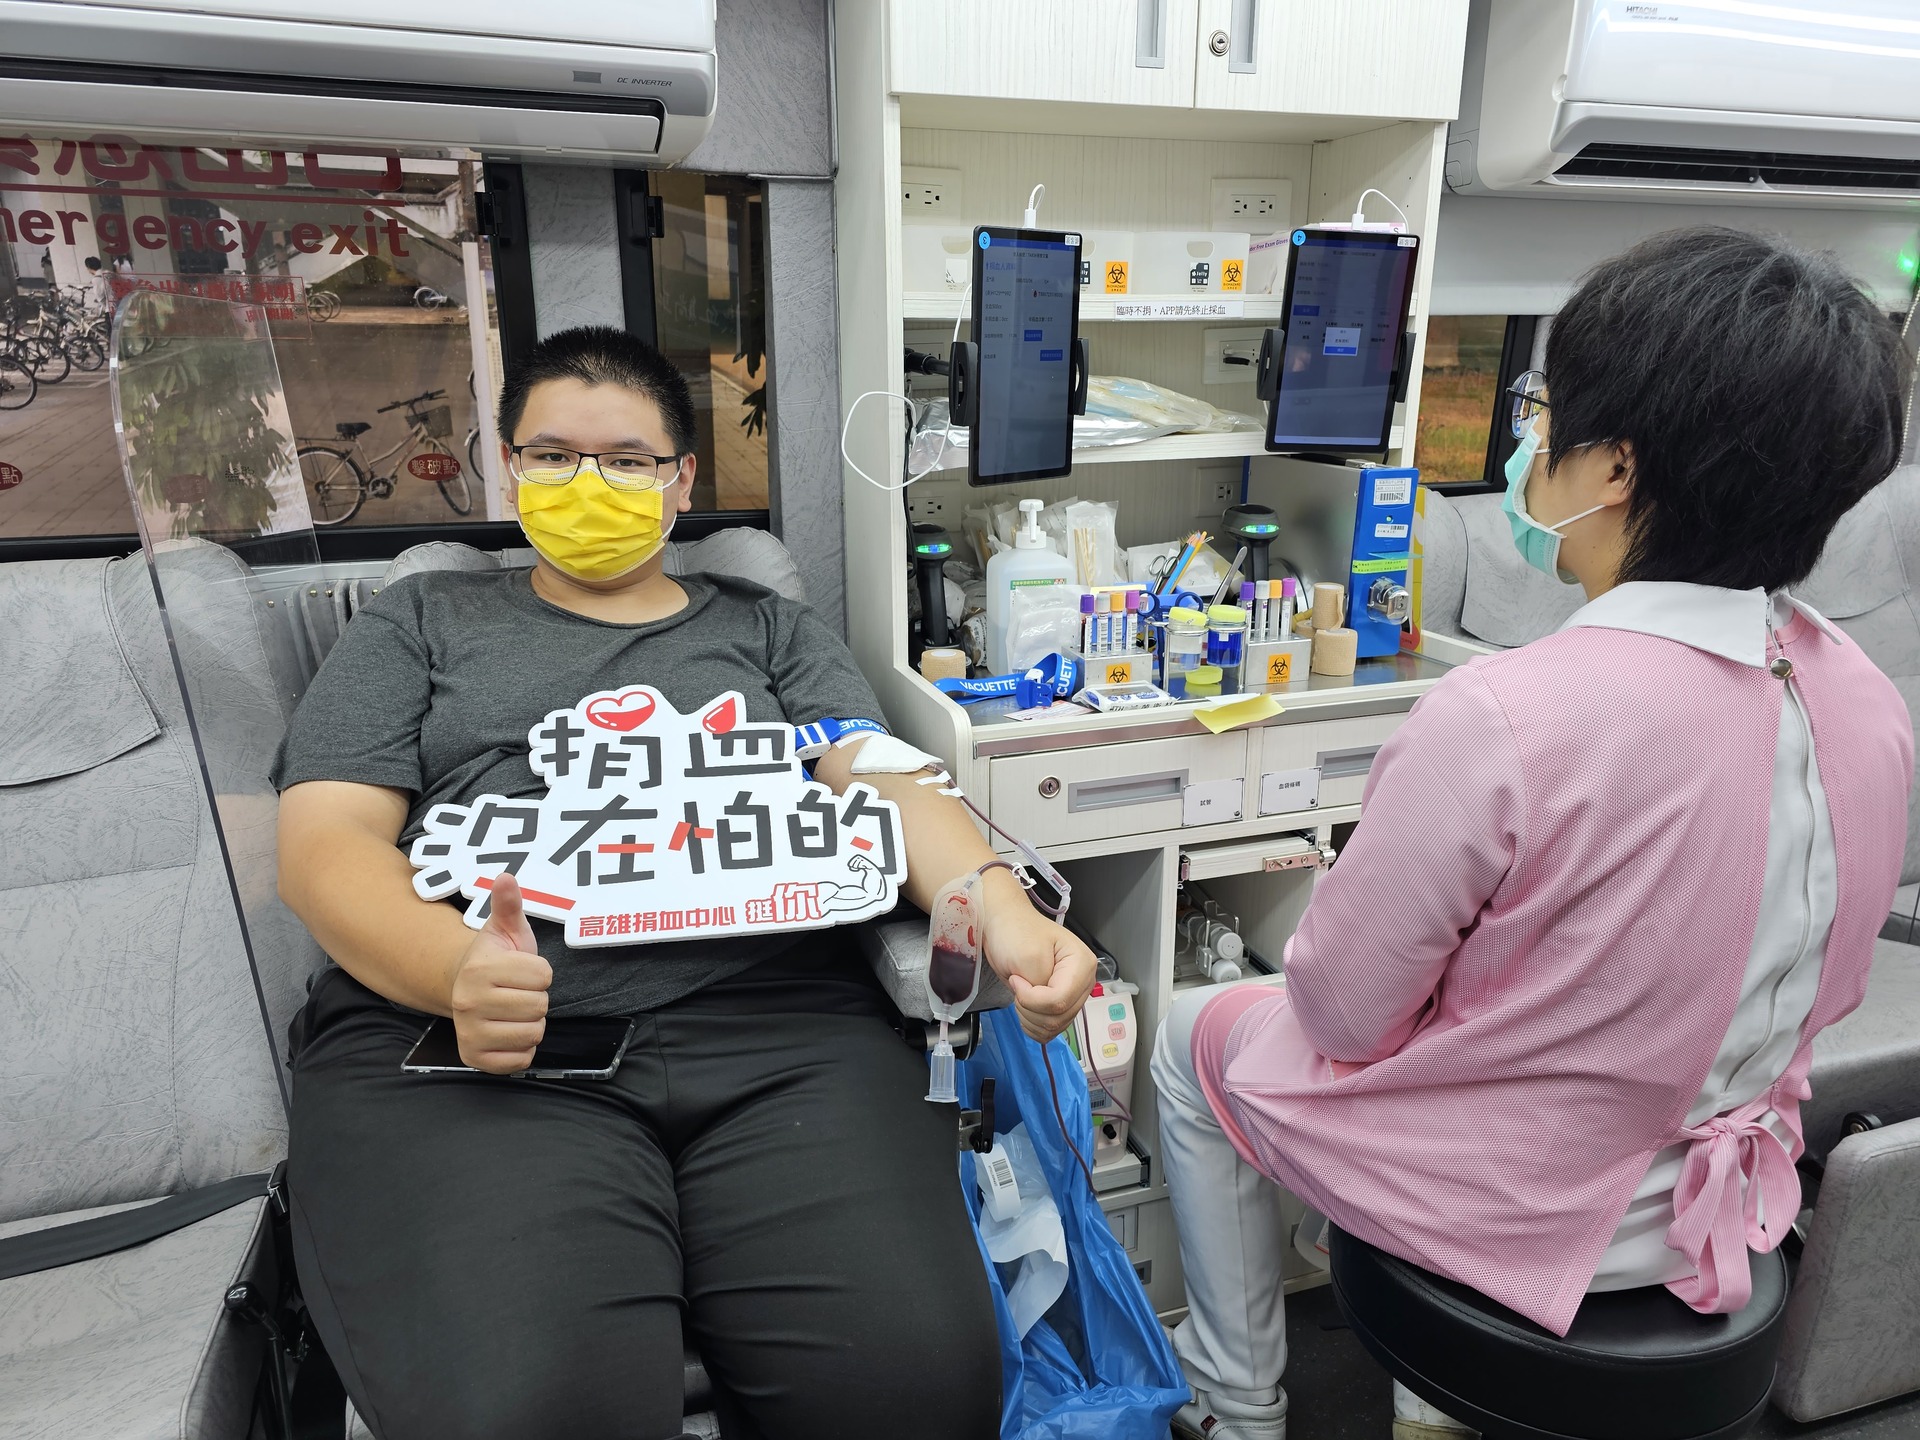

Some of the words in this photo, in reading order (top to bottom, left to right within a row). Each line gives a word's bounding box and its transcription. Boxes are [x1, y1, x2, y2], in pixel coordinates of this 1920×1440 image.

[631, 78, 673, 87] INVERTER
[291, 209, 410, 258] exit
[0, 466, 19, 484] 點
[411, 459, 458, 476] 擊破點
[422, 789, 899, 918] 沒在怕的
[579, 907, 737, 937] 高雄捐血中心
[745, 882, 822, 924] 挺你
[1109, 1007, 1124, 1017] START
[1111, 1027, 1123, 1036] STOP
